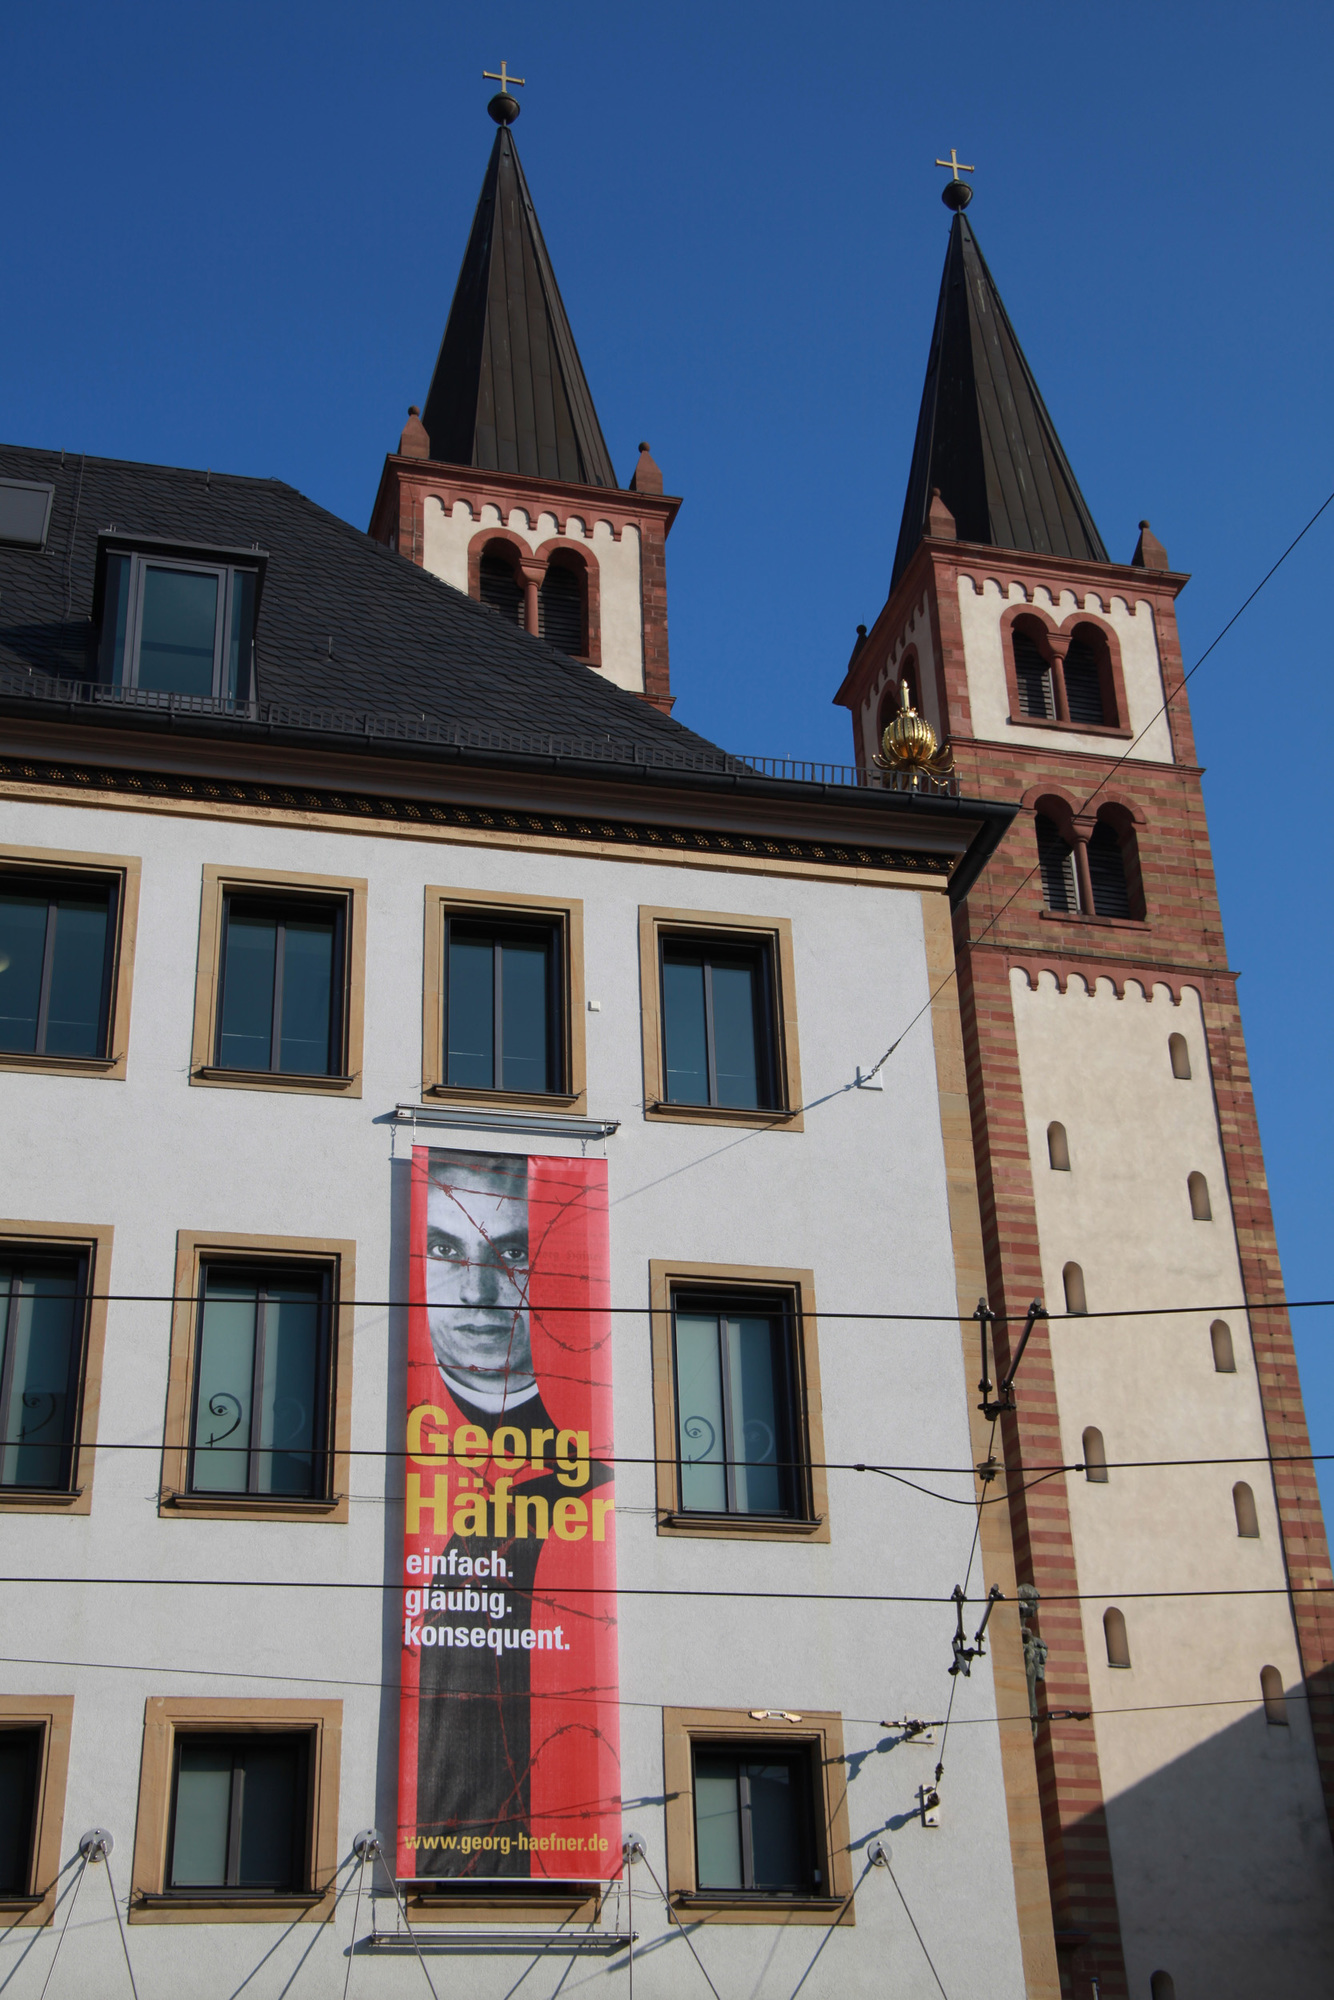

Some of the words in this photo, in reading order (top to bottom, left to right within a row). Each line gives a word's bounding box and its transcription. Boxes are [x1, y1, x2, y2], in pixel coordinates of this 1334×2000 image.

[406, 1404, 590, 1487] Georg
[405, 1472, 615, 1542] Häfner
[405, 1547, 514, 1578] einfach.
[404, 1582, 513, 1620] gläubig.
[404, 1618, 571, 1656] konsequent.
[404, 1832, 609, 1854] www.georg-haefner.de
